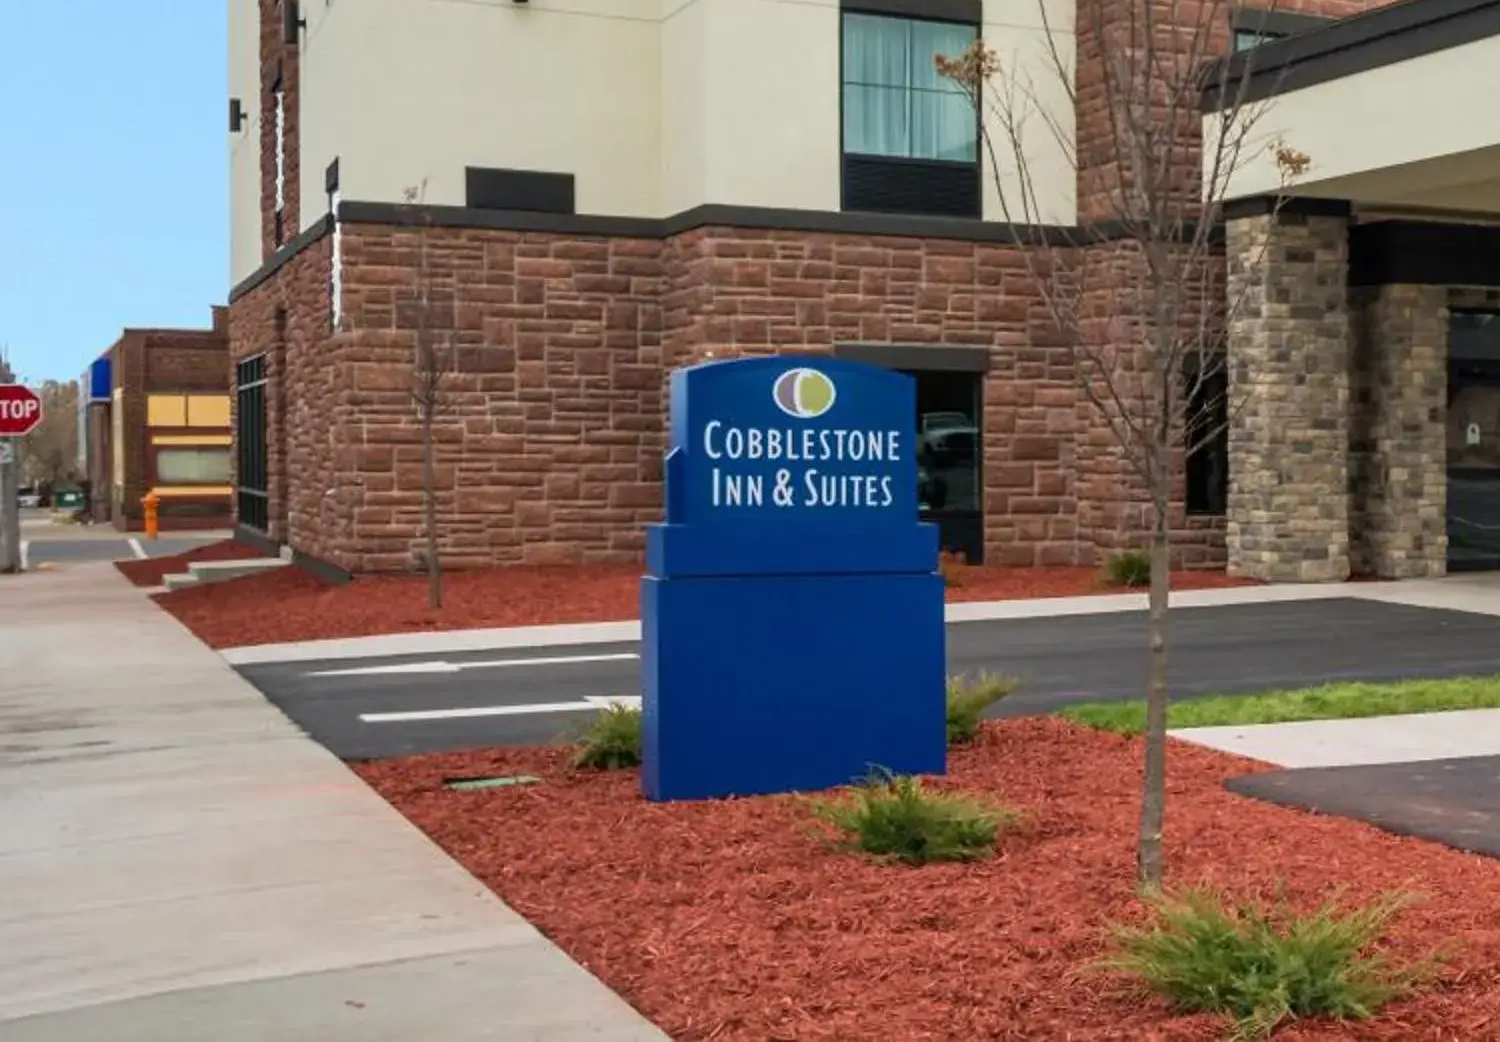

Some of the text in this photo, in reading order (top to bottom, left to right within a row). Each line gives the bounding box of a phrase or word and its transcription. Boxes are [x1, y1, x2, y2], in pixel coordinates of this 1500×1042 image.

[0, 399, 38, 419] TOP
[704, 420, 900, 461] COBBLESTONE
[712, 468, 893, 507] INN & SUITES
